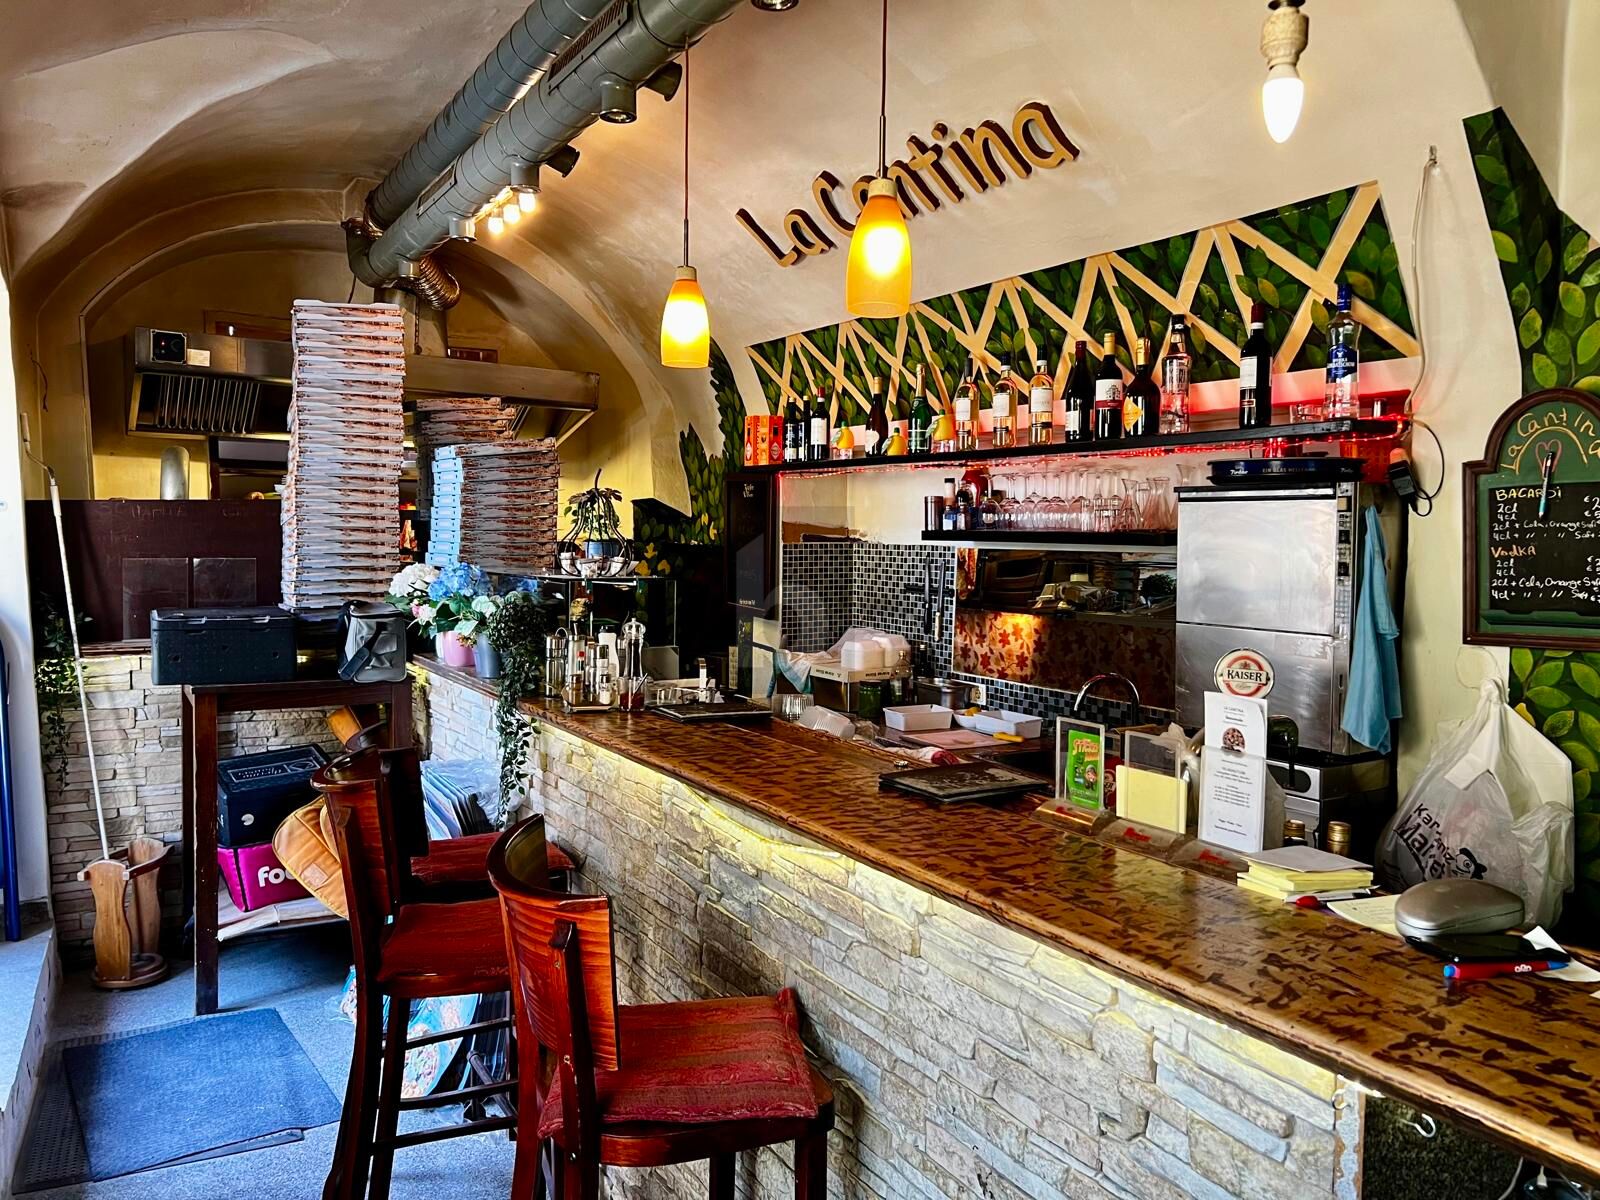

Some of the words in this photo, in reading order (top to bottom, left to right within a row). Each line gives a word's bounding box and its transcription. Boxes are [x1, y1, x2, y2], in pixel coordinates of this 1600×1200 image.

[735, 207, 837, 267] La
[1227, 669, 1263, 682] KAISER
[1395, 814, 1446, 880] Maret
